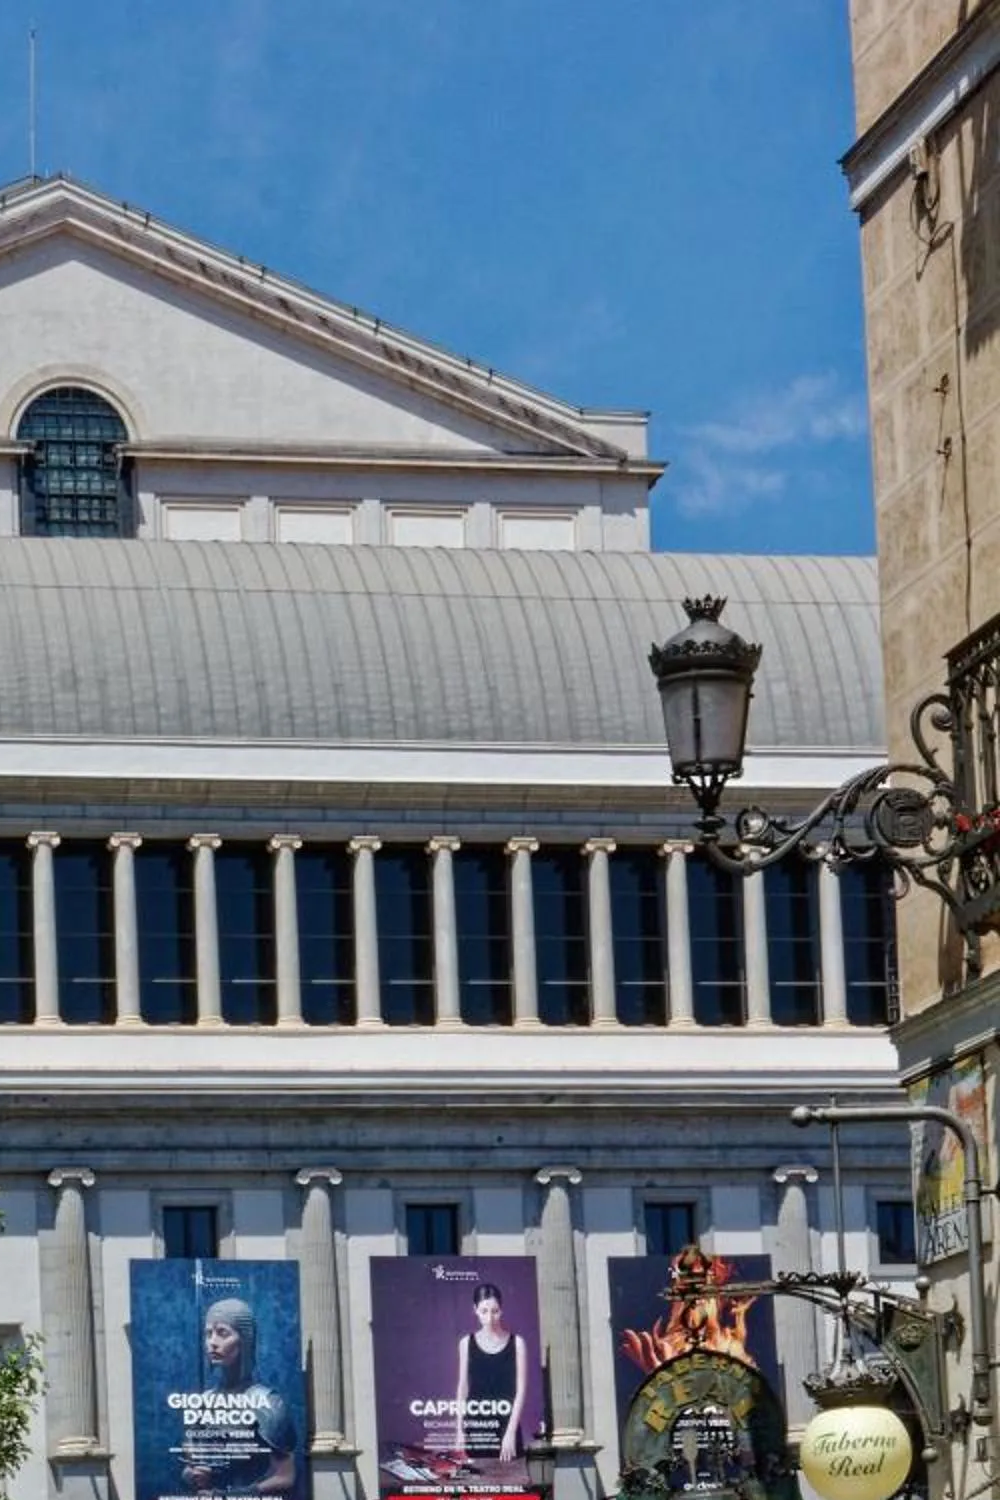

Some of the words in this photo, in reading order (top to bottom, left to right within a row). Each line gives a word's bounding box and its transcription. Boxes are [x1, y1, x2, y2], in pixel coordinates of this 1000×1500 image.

[167, 1393, 272, 1409] GIOVANNA
[409, 1400, 512, 1416] CAPRICCIO
[183, 1409, 256, 1425] D'ARCO
[814, 1431, 898, 1454] Taberna
[828, 1451, 885, 1477] Real
